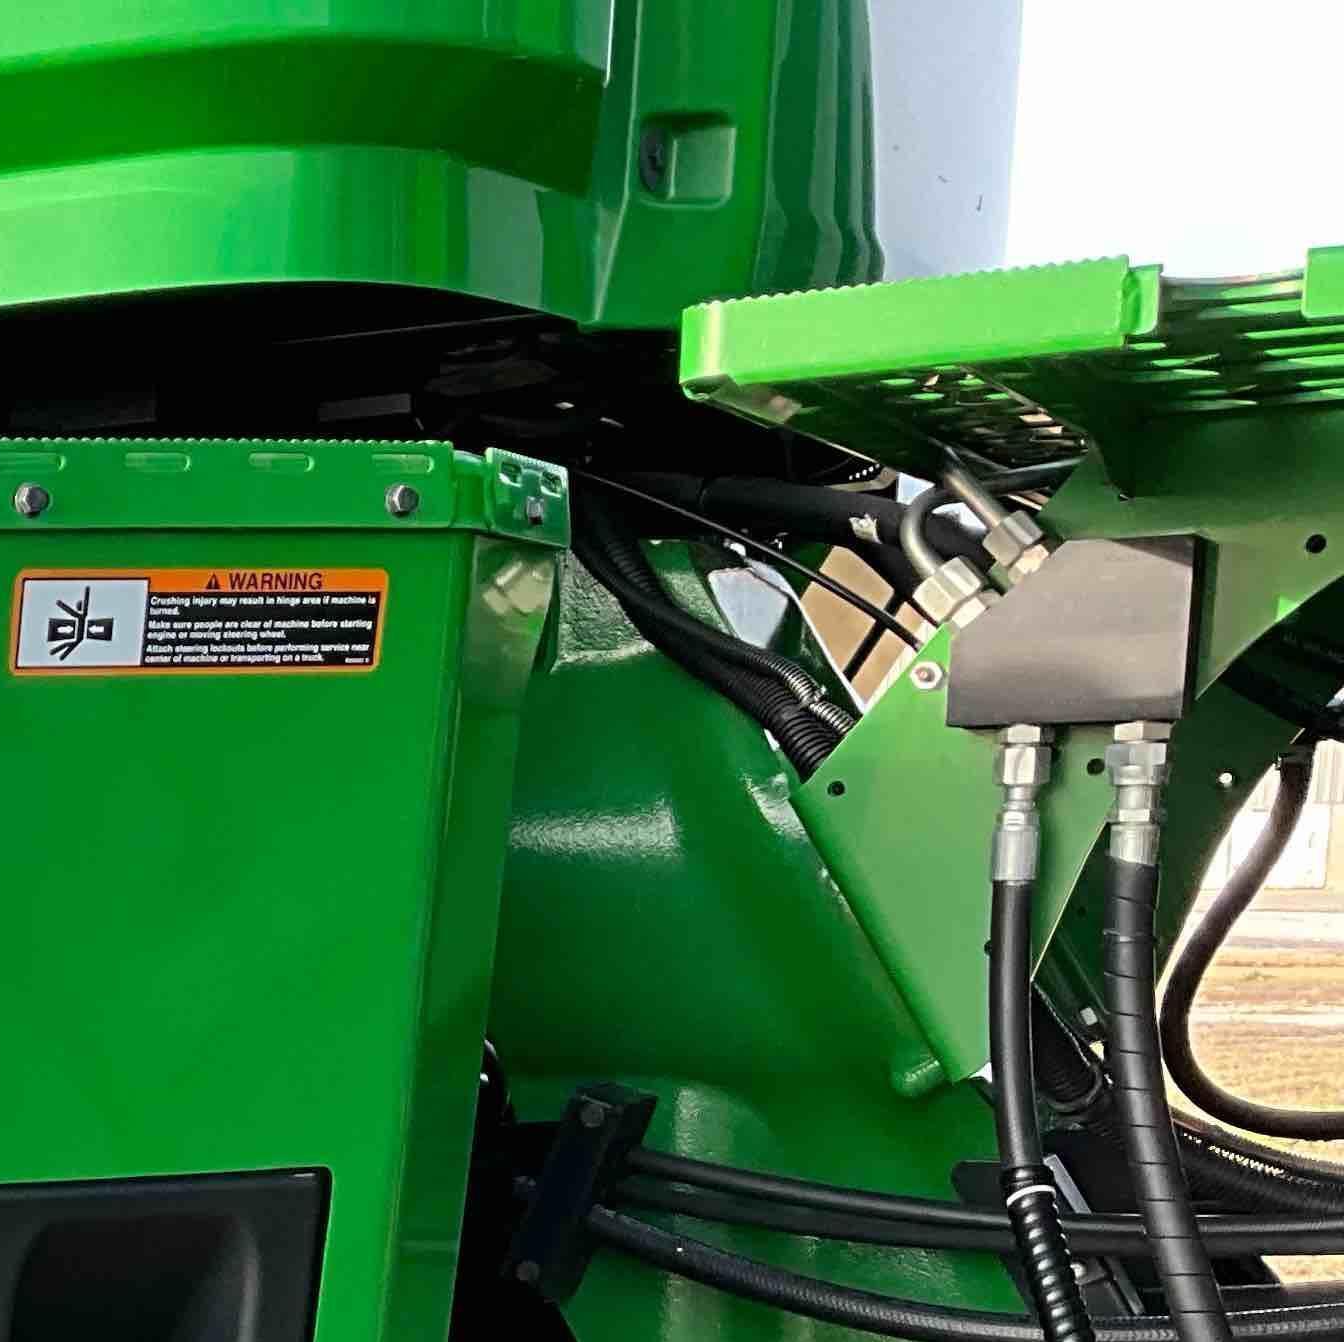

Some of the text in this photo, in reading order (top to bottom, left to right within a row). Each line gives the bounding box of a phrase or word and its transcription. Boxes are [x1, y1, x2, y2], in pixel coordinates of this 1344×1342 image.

[228, 572, 323, 591] WARNING
[150, 595, 376, 607] Crushing injury may result in hinge area if machine is
[149, 606, 180, 616] turned.
[148, 618, 372, 631] Make sure people are clear of machine before starting
[146, 630, 287, 641] engine or moving steering wheel.
[146, 644, 173, 653] Attach
[174, 644, 209, 654] steering
[246, 643, 273, 652] before
[274, 643, 319, 654] performing
[320, 643, 350, 652] service
[144, 655, 172, 663] center
[173, 653, 182, 663] of
[183, 654, 219, 663] machine
[230, 653, 281, 664] transporting
[282, 654, 293, 662] on
[294, 654, 301, 662] a
